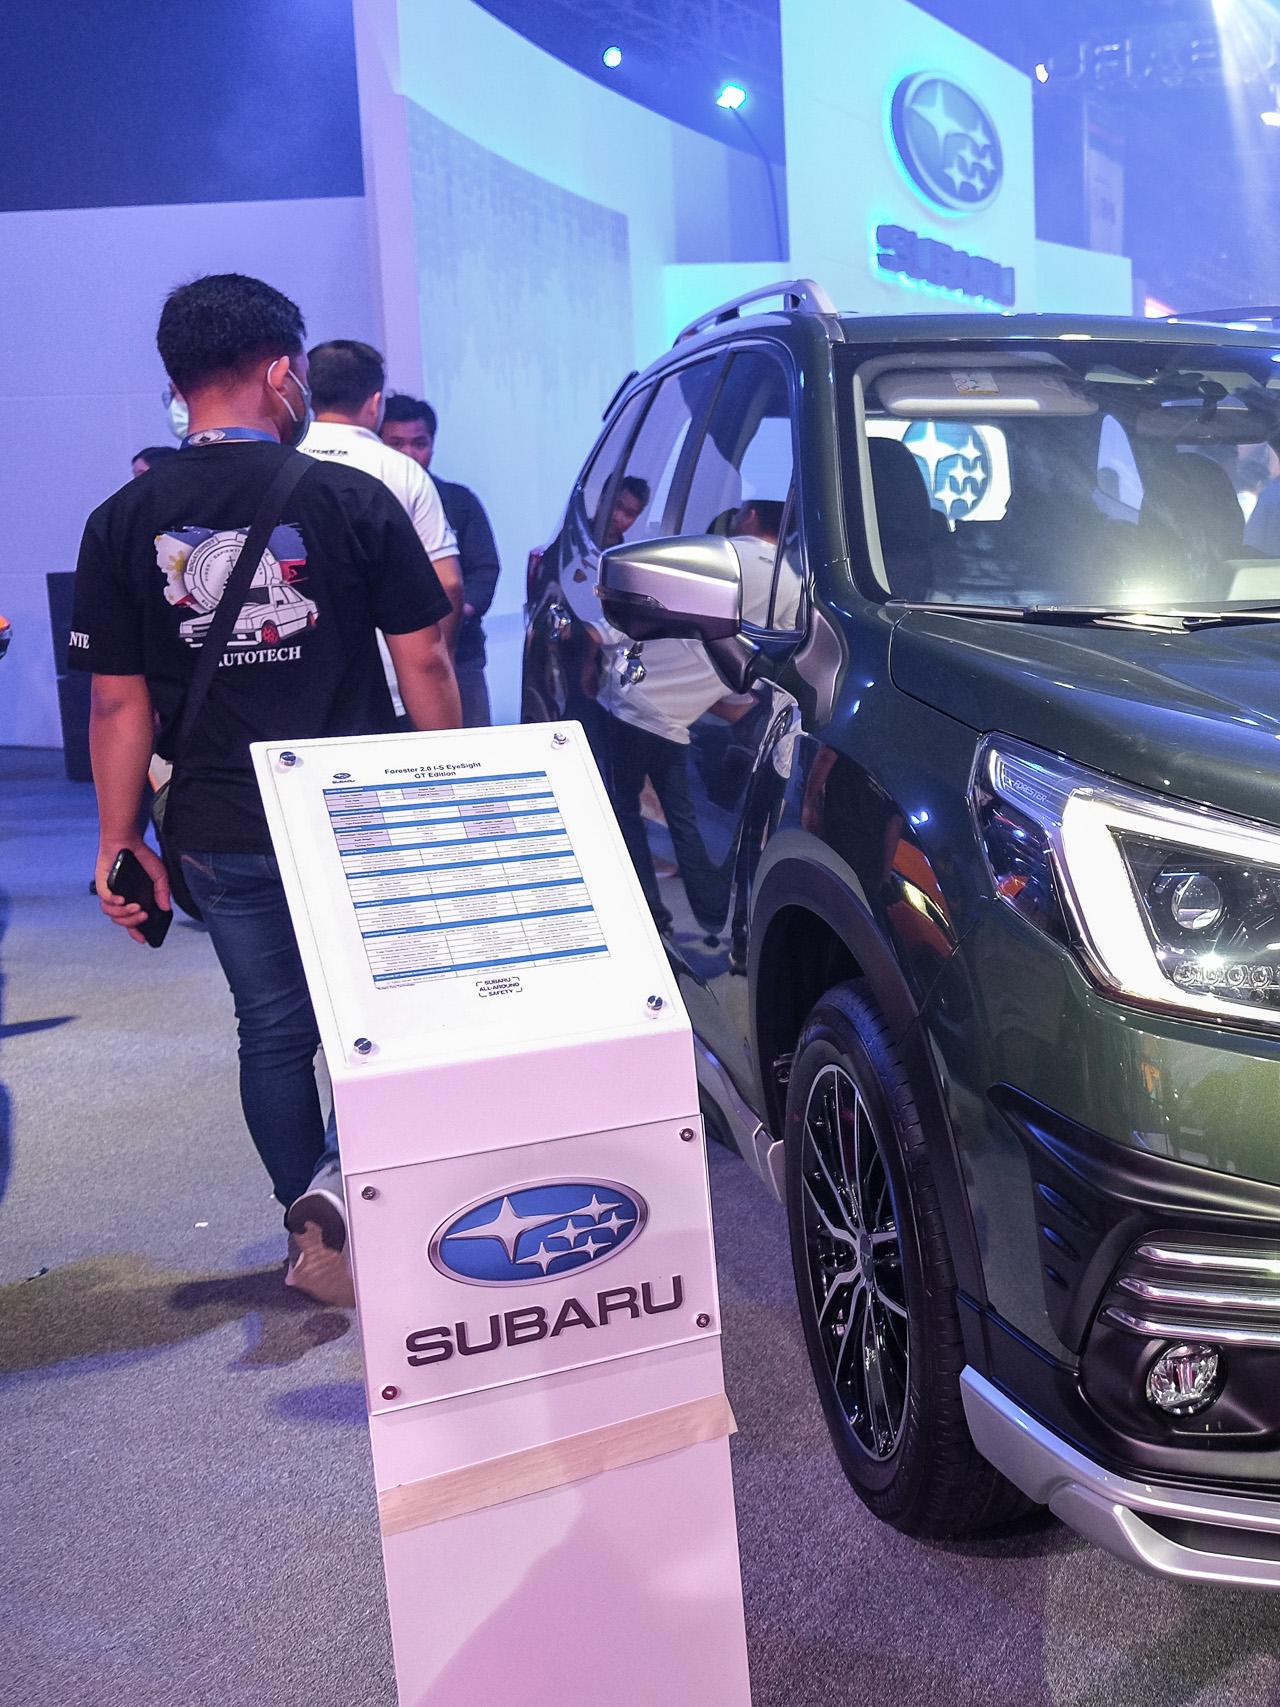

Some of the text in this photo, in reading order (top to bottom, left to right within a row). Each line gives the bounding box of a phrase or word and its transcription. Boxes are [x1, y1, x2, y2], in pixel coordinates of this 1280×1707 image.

[384, 767, 418, 775] Forester
[446, 762, 482, 770] EyeSight
[1013, 779, 1048, 803] FORESTER
[484, 977, 512, 985] SUBARU
[479, 982, 520, 992] ALL-AROUND
[488, 989, 514, 997] SAFETY
[405, 1274, 684, 1367] SUBARU
